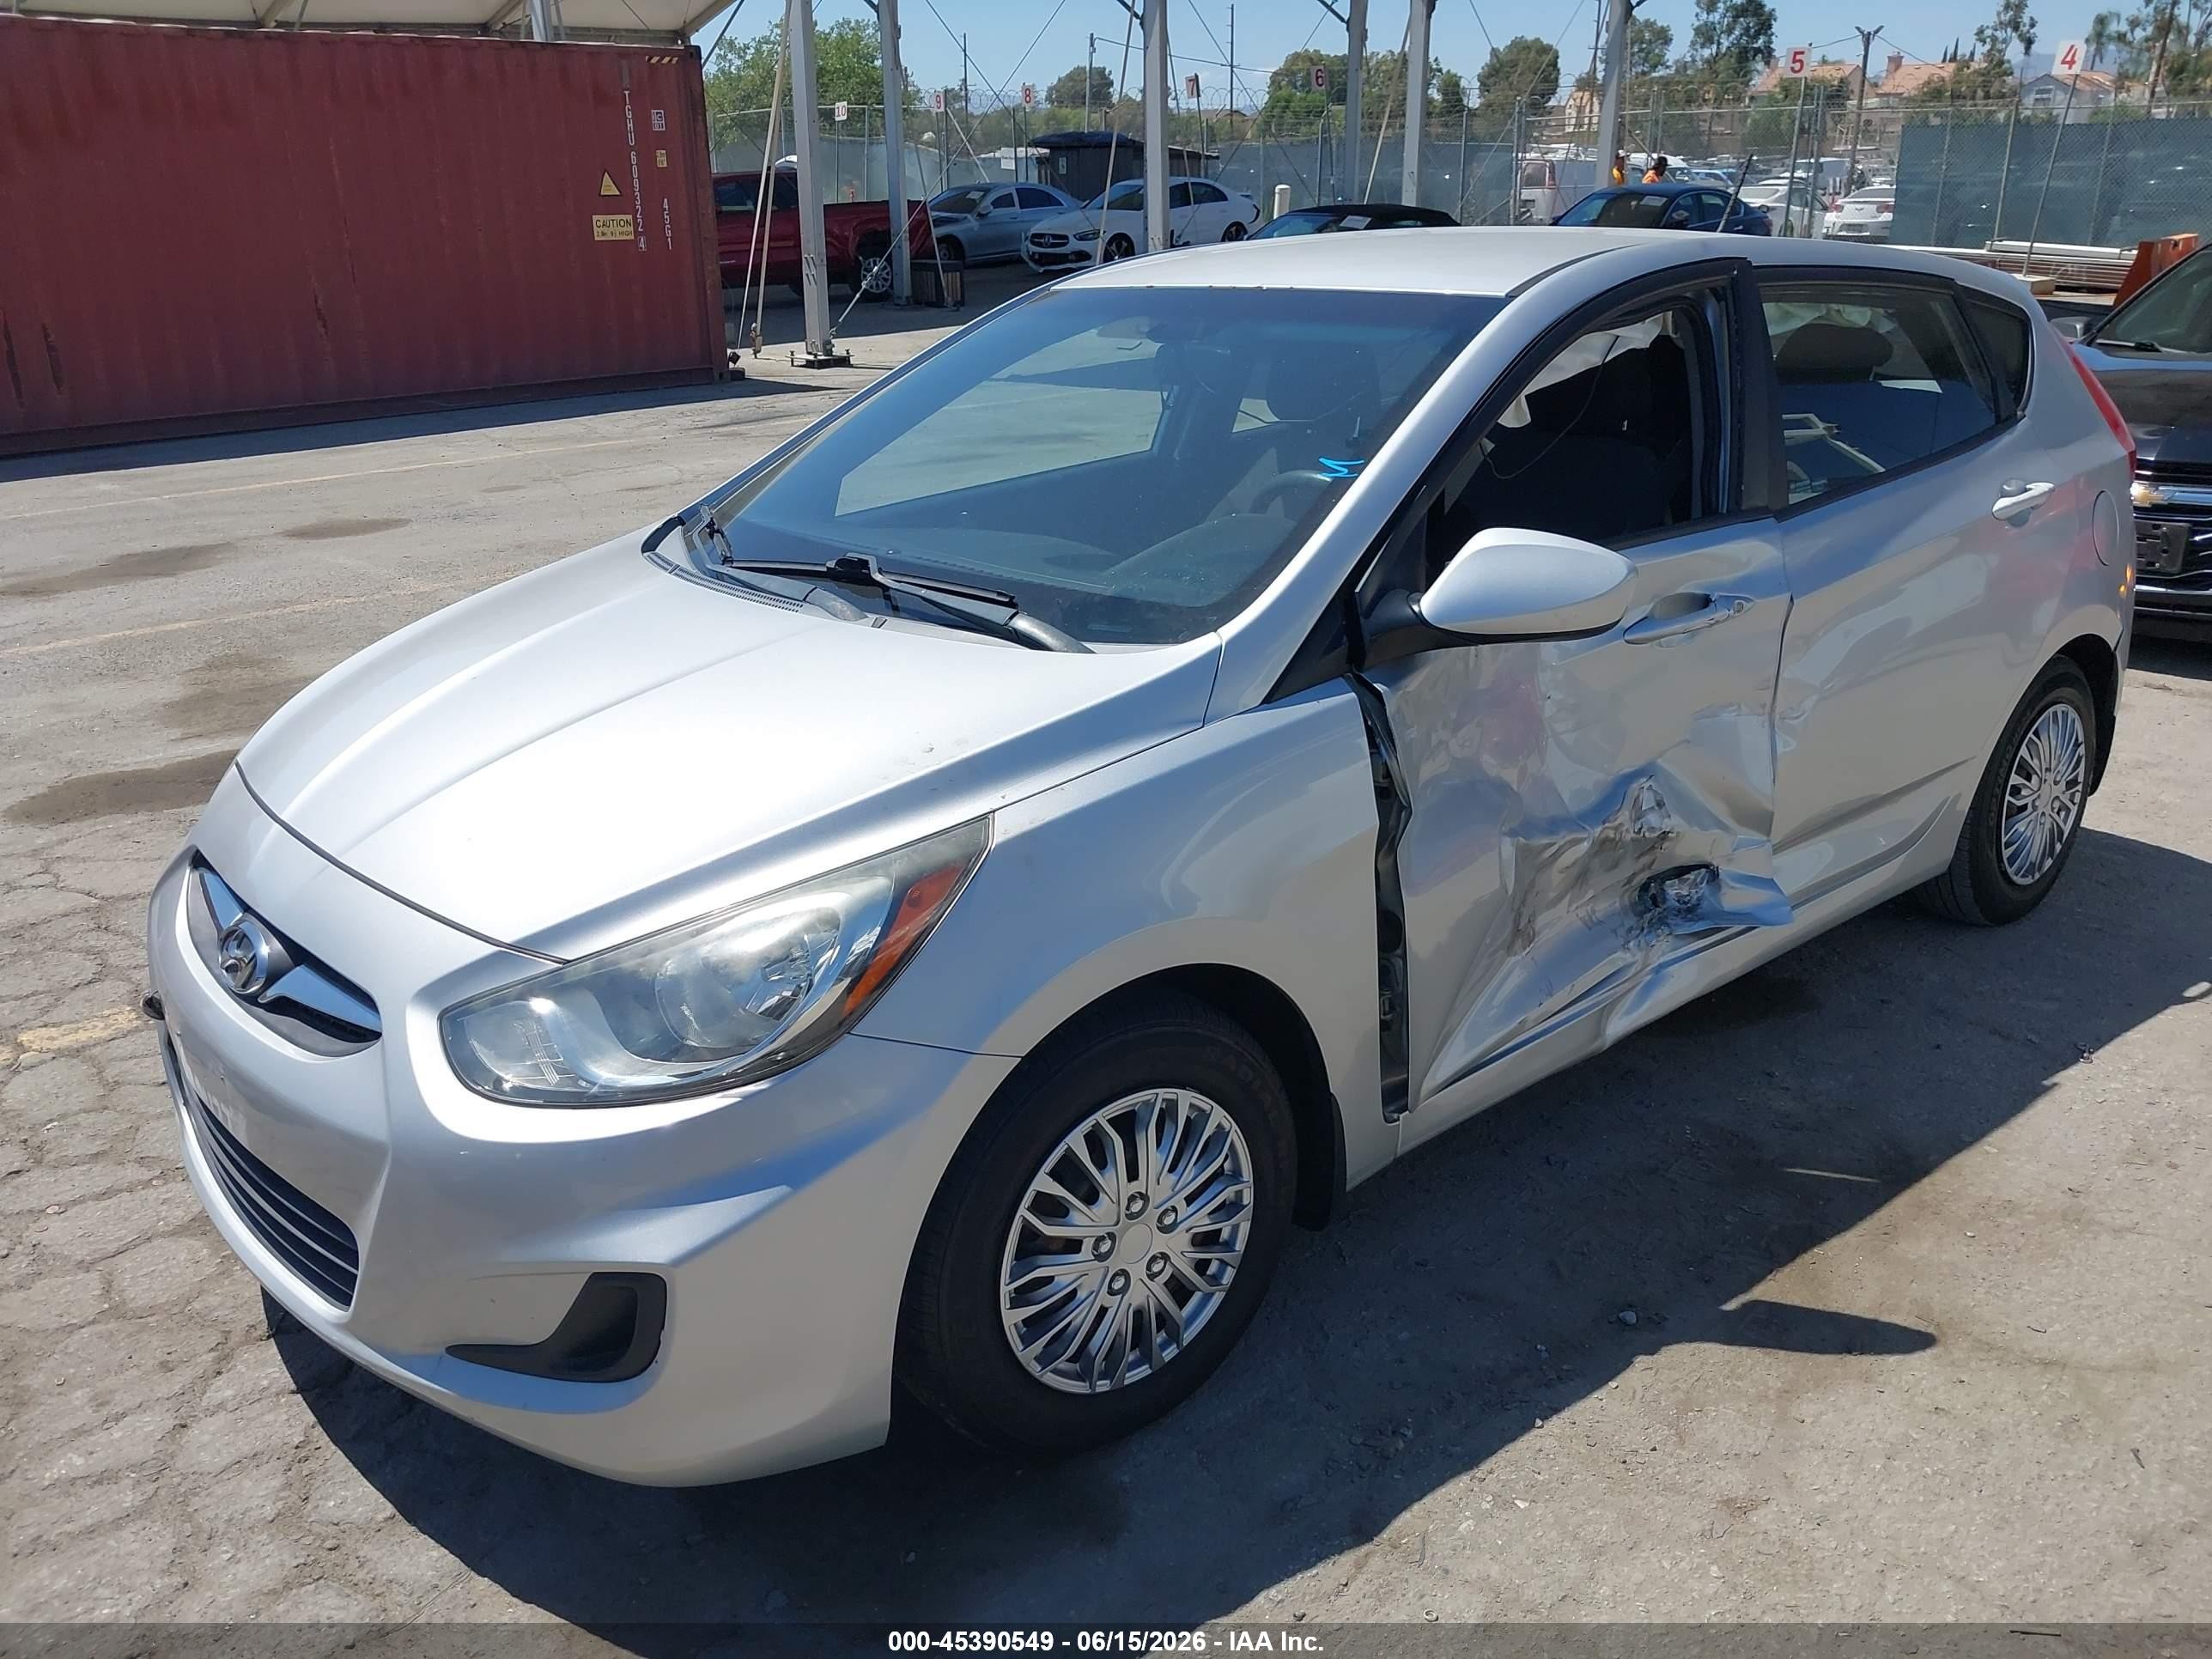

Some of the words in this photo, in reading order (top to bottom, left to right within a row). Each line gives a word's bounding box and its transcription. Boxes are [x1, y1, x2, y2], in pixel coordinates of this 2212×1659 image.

[1790, 51, 1805, 74] 5
[2060, 45, 2078, 70] 4
[1315, 68, 1324, 87] 6
[1024, 88, 1031, 104] 8
[1188, 78, 1196, 96] 7
[935, 94, 941, 109] 9
[836, 105, 847, 117] 10
[623, 90, 635, 146] TGHU
[630, 150, 644, 232] 609322
[595, 218, 632, 229] CAUTION
[662, 198, 672, 251] 45G1
